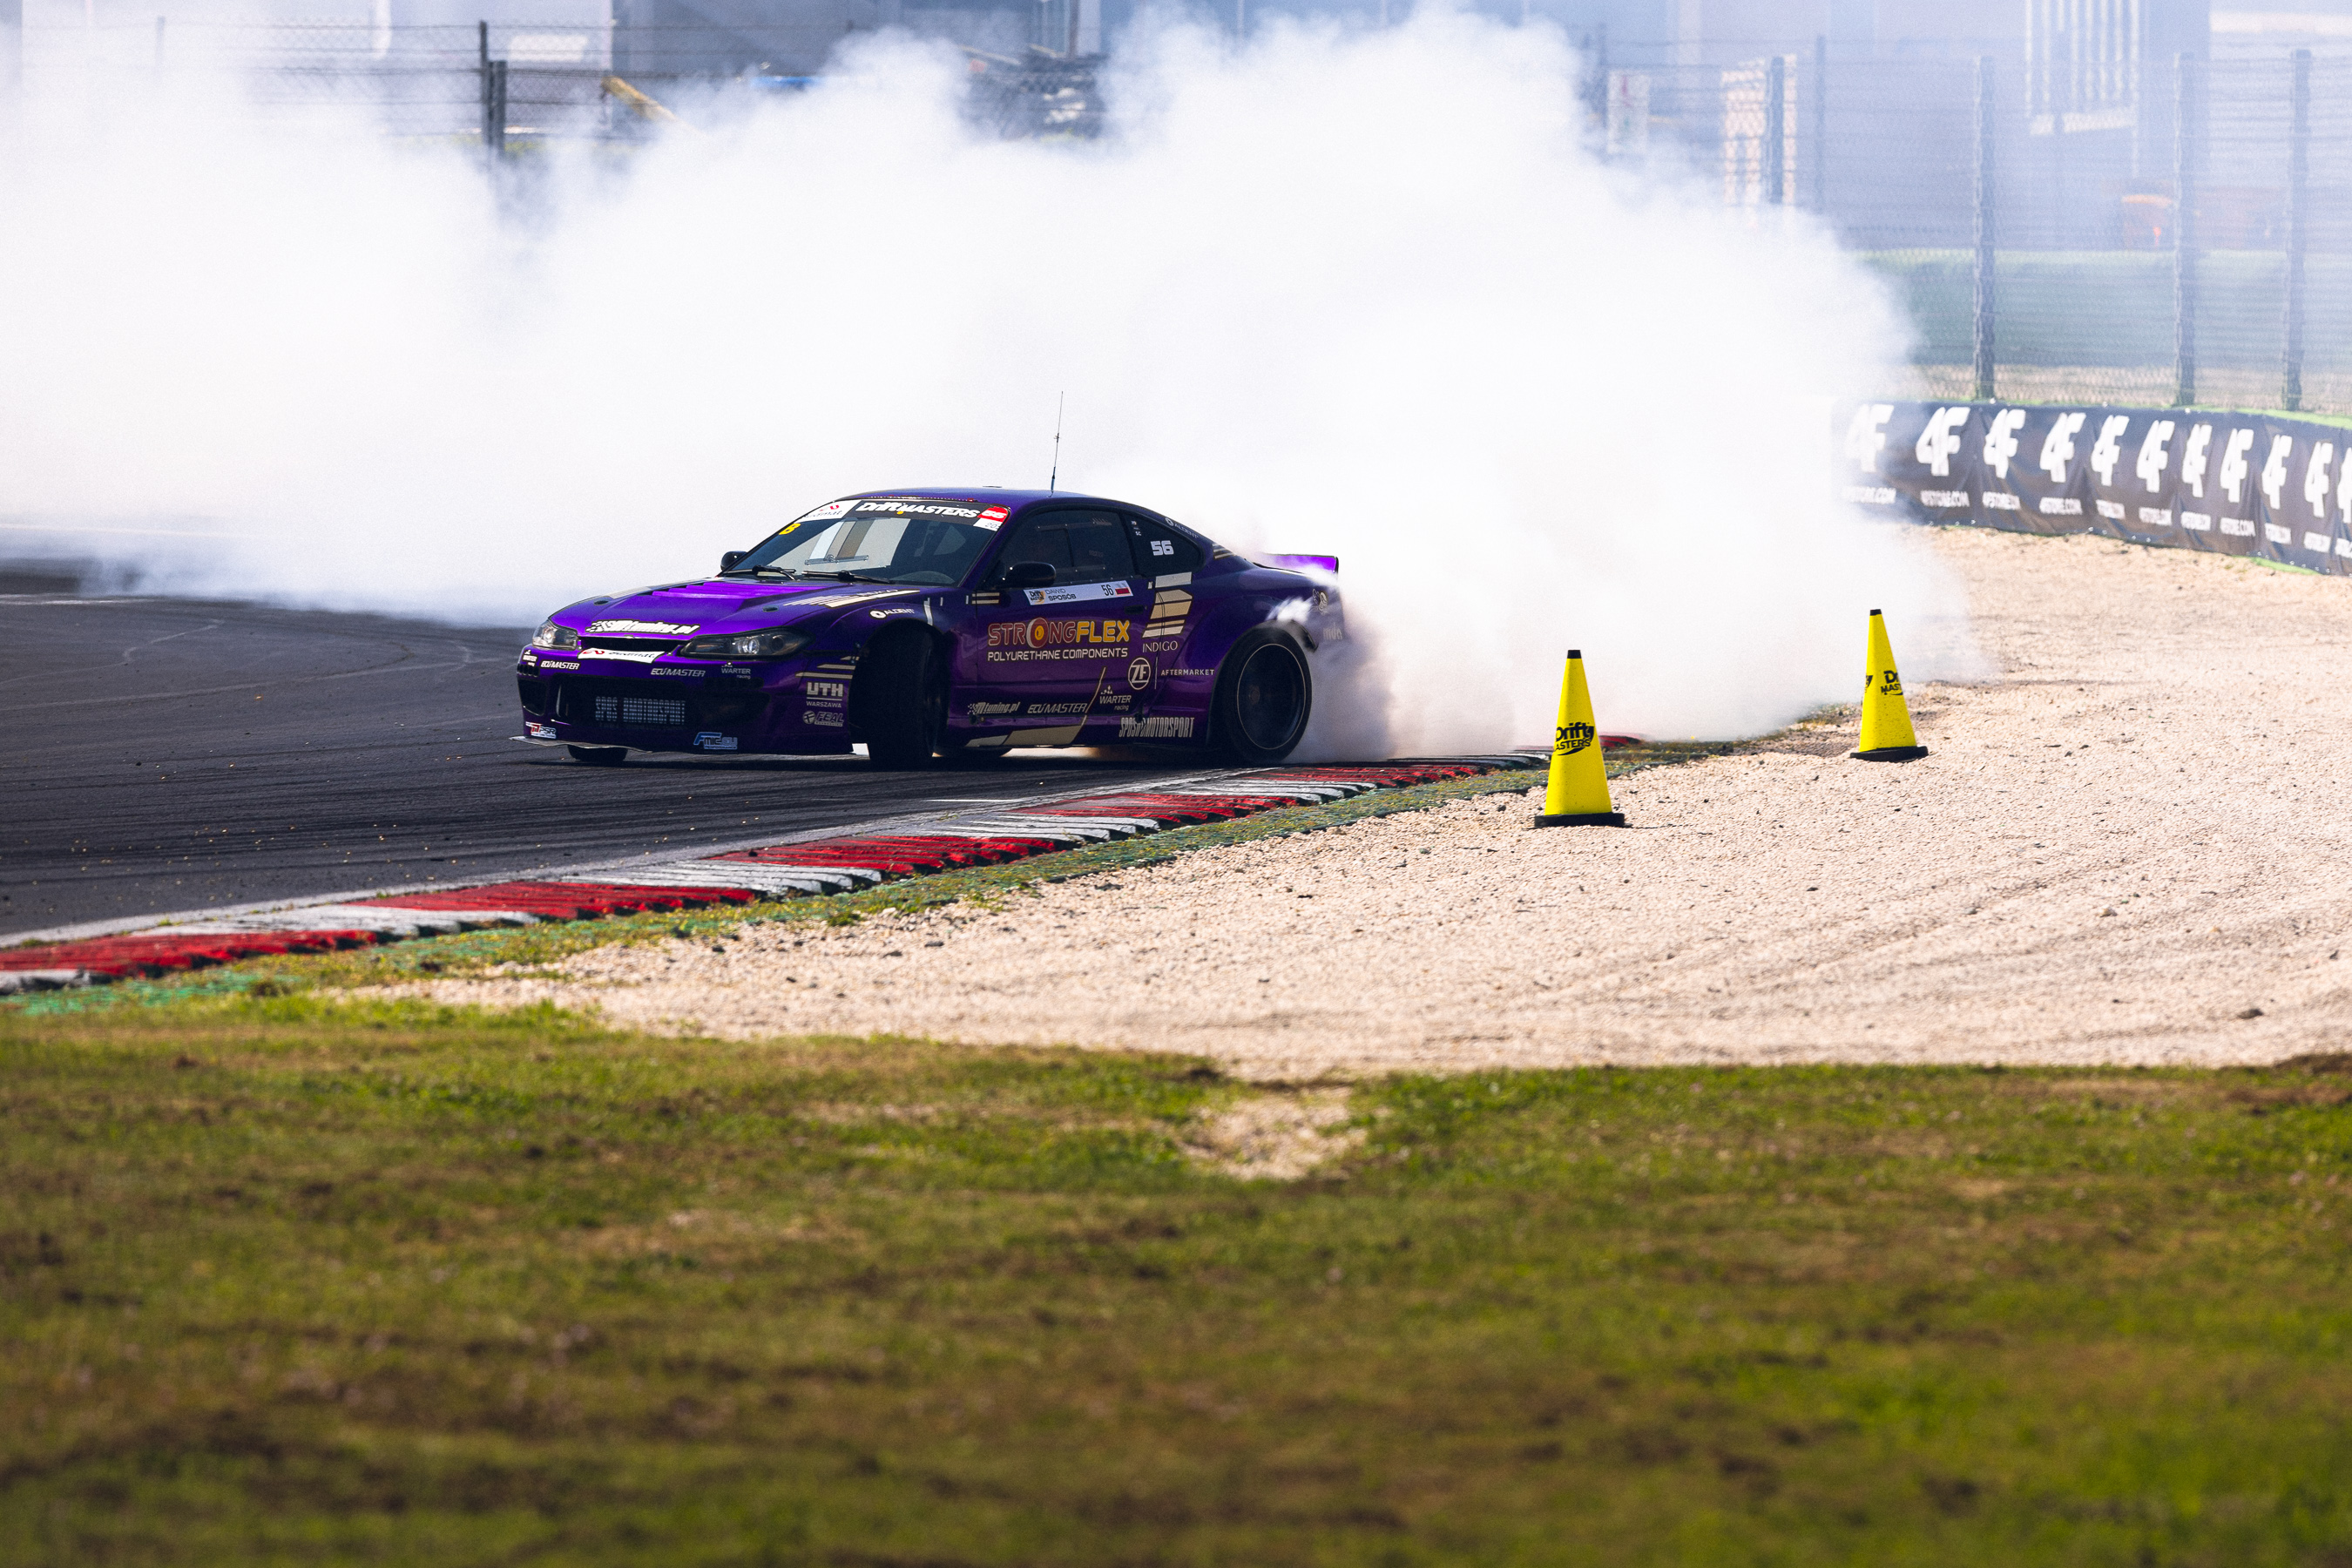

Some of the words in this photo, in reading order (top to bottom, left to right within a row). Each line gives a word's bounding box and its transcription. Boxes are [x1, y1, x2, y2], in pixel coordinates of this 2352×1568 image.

[1916, 406, 1971, 476] 4F
[1983, 408, 2026, 479] 4F
[2039, 412, 2086, 483] 4F
[2091, 414, 2130, 487] 4F
[2136, 419, 2175, 493] 4F
[2181, 423, 2213, 498] 4F
[2220, 428, 2254, 503] 4F
[2261, 434, 2293, 510] 4F
[2304, 441, 2334, 518] 4F
[1150, 540, 1174, 556] 56
[1101, 585, 1114, 596] 56
[988, 617, 1130, 648] STRONGFLEX
[988, 650, 1060, 661] POLYURETHANE
[1063, 647, 1128, 659] COMPONENTS
[1142, 640, 1179, 652] INDIGO
[807, 681, 844, 697] UTH
[1099, 694, 1132, 705] WARTER
[814, 711, 845, 724] FEAL
[1555, 739, 1592, 751] ASTERS
